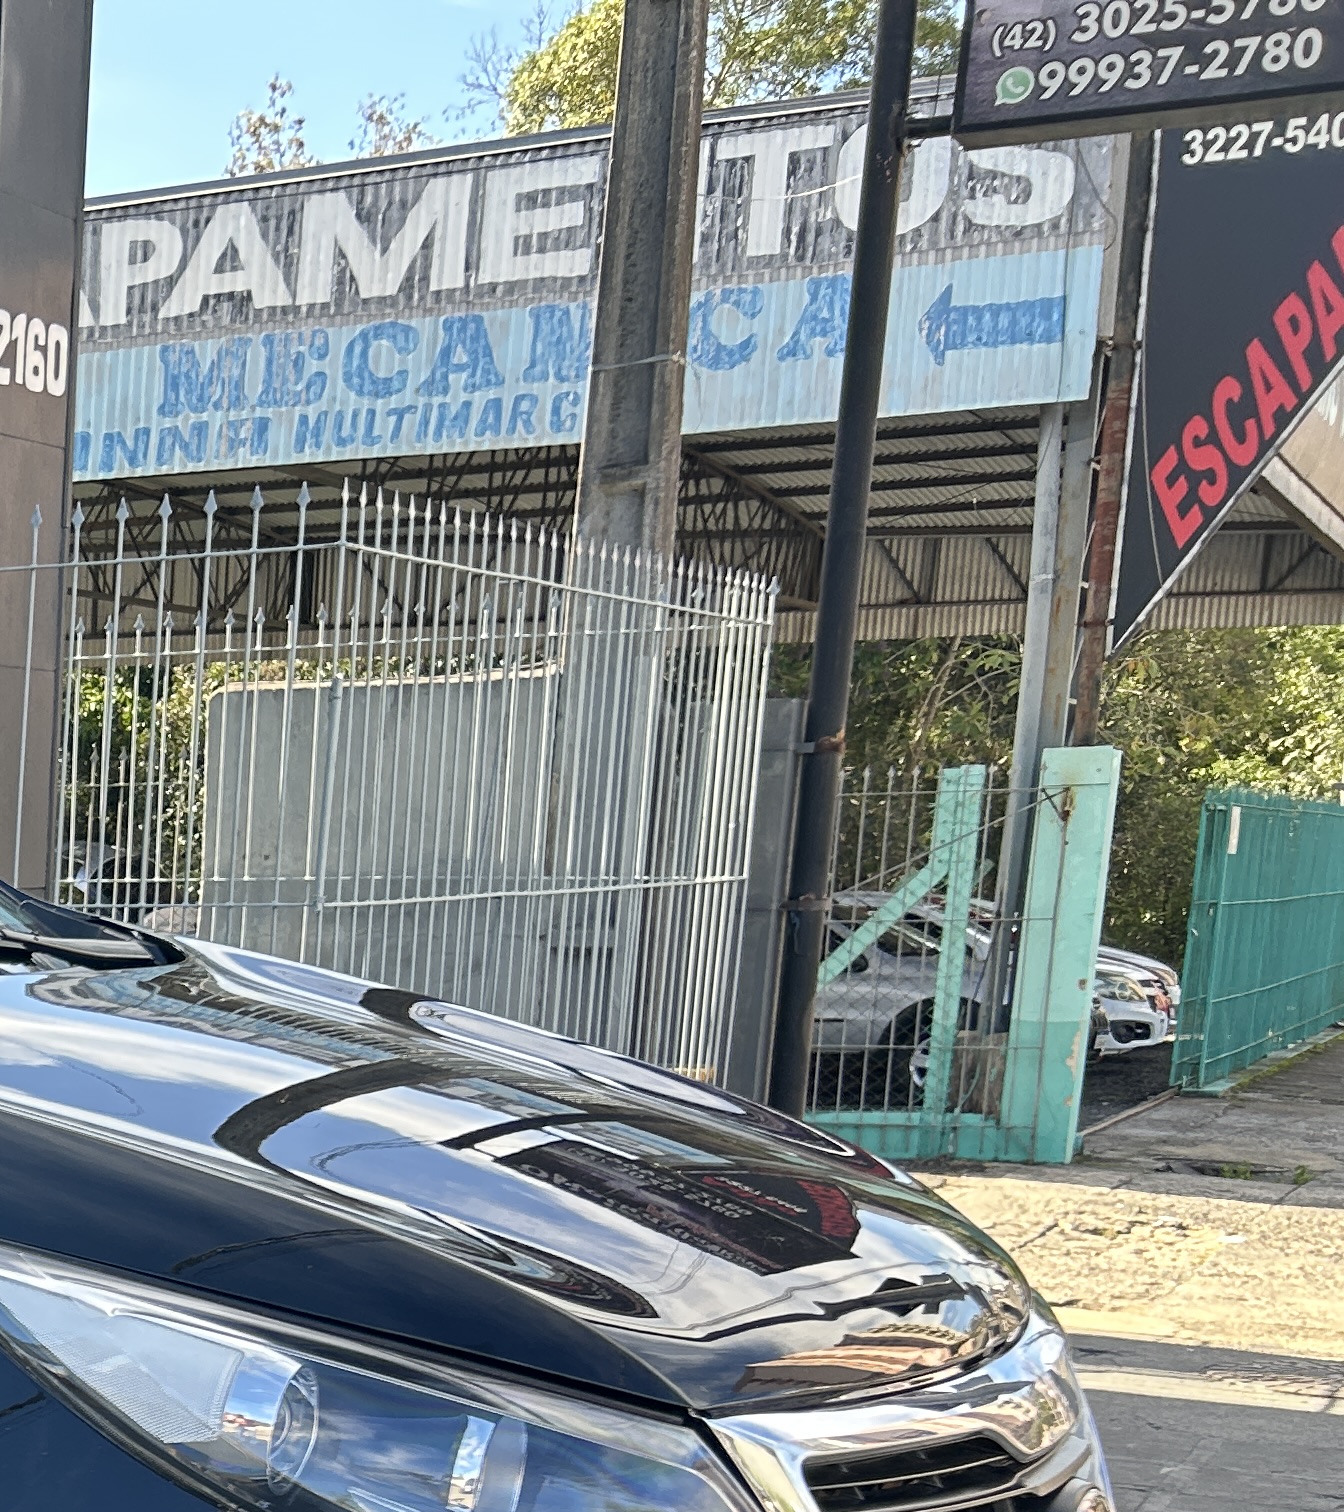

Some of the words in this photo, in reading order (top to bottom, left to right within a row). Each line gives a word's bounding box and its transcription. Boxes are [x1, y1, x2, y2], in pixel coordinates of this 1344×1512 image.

[990, 18, 1057, 57] (42)
[1037, 27, 1324, 100] 99937-2780
[157, 272, 854, 419] MECANCA
